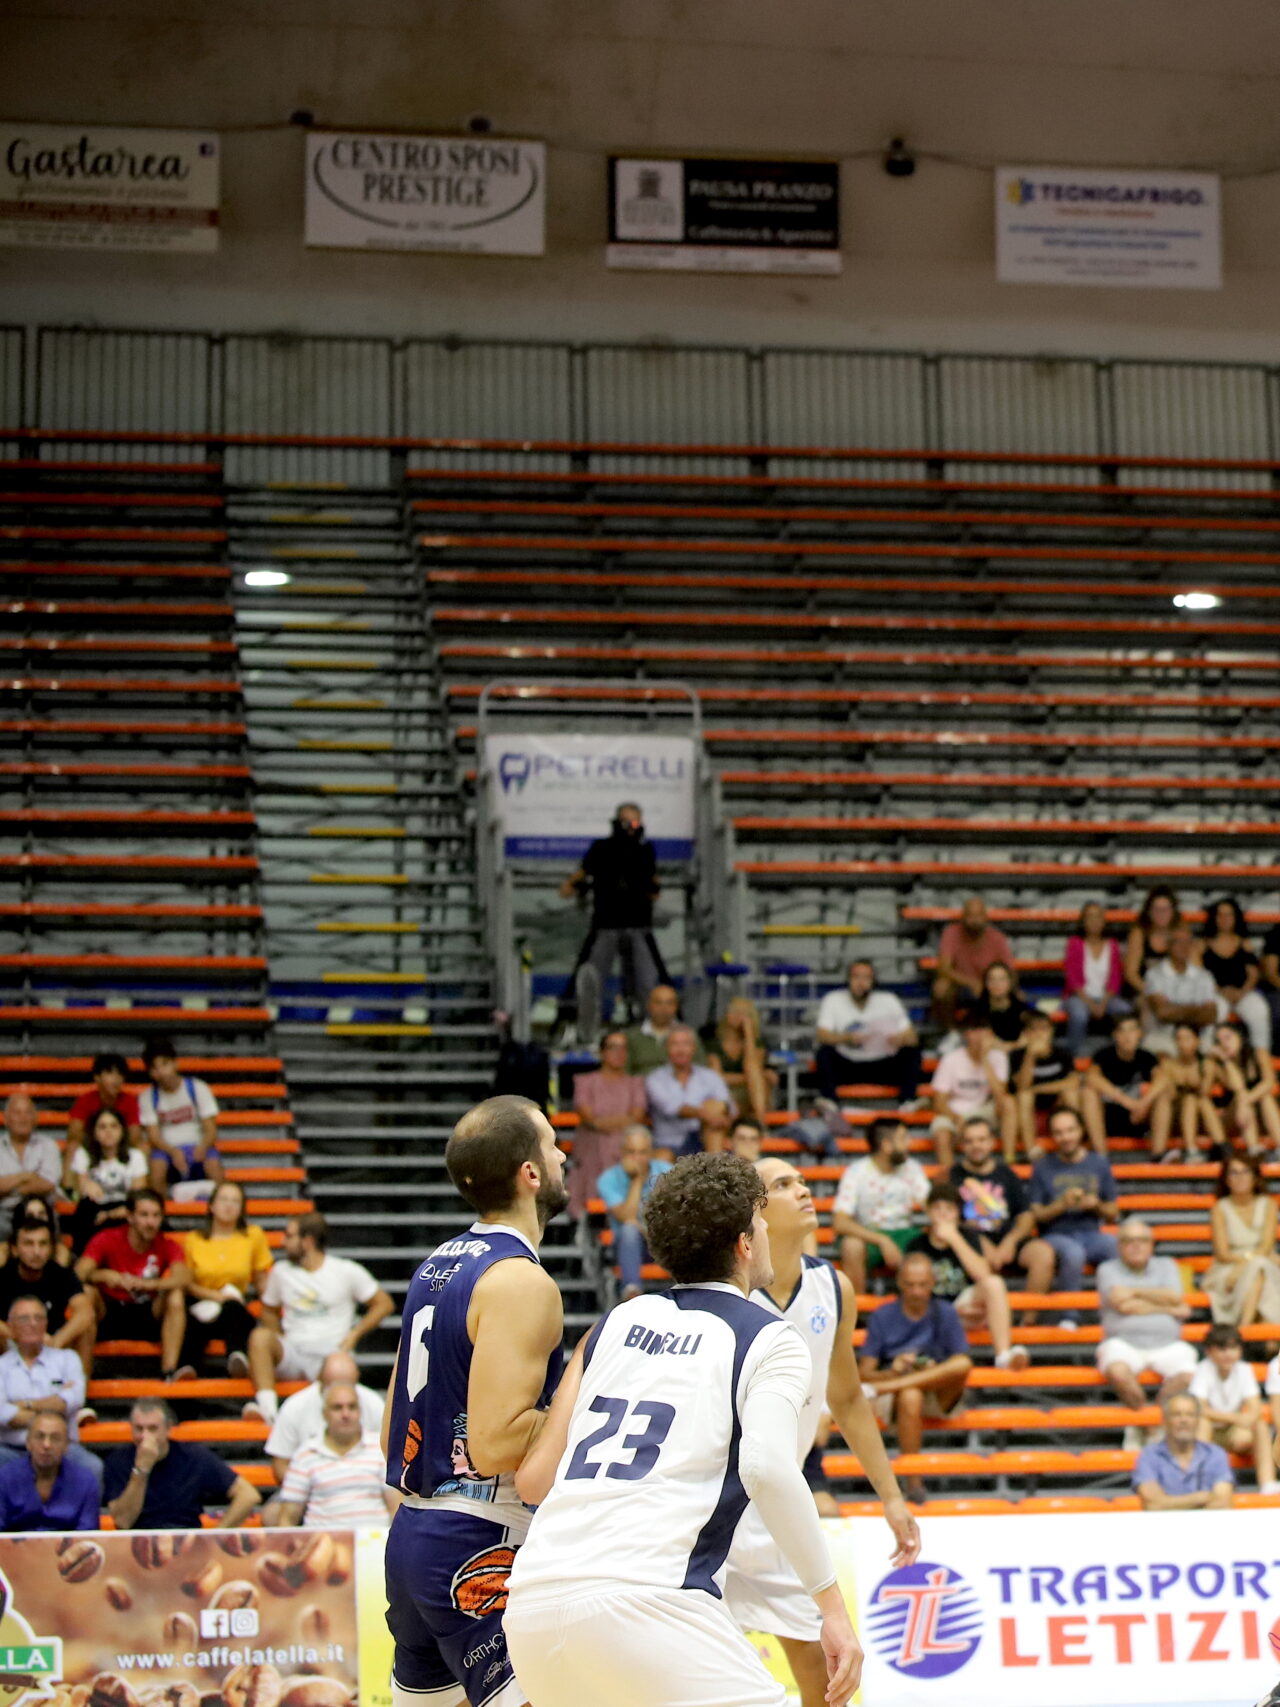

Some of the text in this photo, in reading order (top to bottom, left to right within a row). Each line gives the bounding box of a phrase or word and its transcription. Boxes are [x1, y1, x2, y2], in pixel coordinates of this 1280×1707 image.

[7, 135, 191, 182] Gastarea
[331, 139, 520, 176] CENTRO SPOSI
[363, 172, 490, 208] PRESTIGE
[533, 754, 685, 779] PETRELLI
[407, 1304, 436, 1403] 6
[564, 1395, 676, 1480] 23
[117, 1644, 345, 1670] www.caffelatella.it
